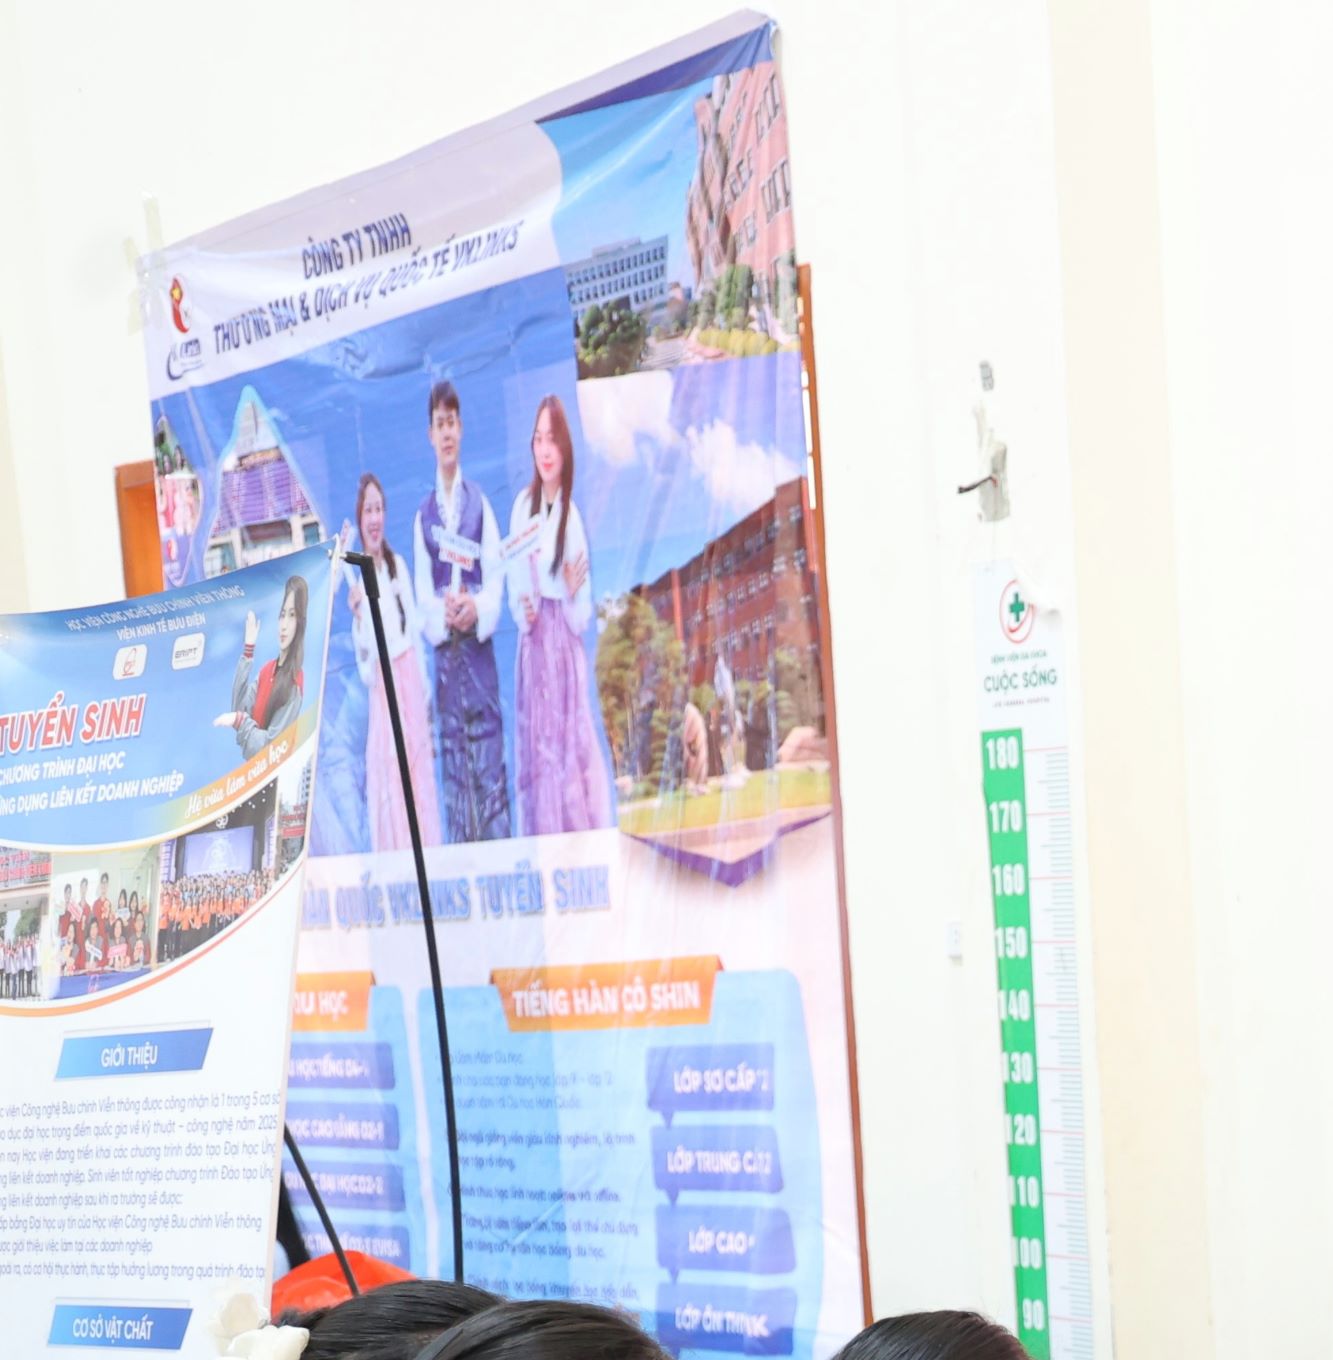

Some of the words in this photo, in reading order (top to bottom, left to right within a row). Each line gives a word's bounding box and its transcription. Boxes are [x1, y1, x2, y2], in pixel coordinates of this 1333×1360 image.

[302, 236, 344, 279] CÔNG
[343, 231, 364, 267] TY
[365, 212, 412, 258] TNHH
[984, 670, 1018, 696] CUỘC
[1022, 664, 1057, 688] SỐNG
[81, 695, 145, 743] SINH
[43, 757, 75, 778] TRÌNH
[77, 757, 97, 777] ĐẠI
[100, 751, 125, 774] HỌC
[986, 736, 1019, 770] 180
[50, 786, 73, 808] LIÊN
[75, 781, 96, 804] KẾT
[97, 780, 139, 801] DOANH
[140, 770, 184, 796] NGHIỆP
[989, 800, 1021, 833] 170
[992, 863, 1025, 896] 160
[995, 927, 1028, 958] 150
[512, 982, 570, 1018] TIẾNG
[573, 979, 619, 1015] HÀN
[621, 983, 649, 1012] CÔ
[649, 980, 700, 1009] SHIN
[998, 990, 1030, 1022] 140
[101, 1044, 125, 1067] GIỚI
[127, 1042, 158, 1069] THIỆU
[1001, 1052, 1033, 1085] 130
[1005, 1114, 1037, 1146] 120
[1010, 1176, 1040, 1209] 110
[1012, 1237, 1042, 1270] 100
[104, 1316, 123, 1344] VẬT
[124, 1314, 154, 1341] CHẤT
[1022, 1299, 1045, 1331] 90
